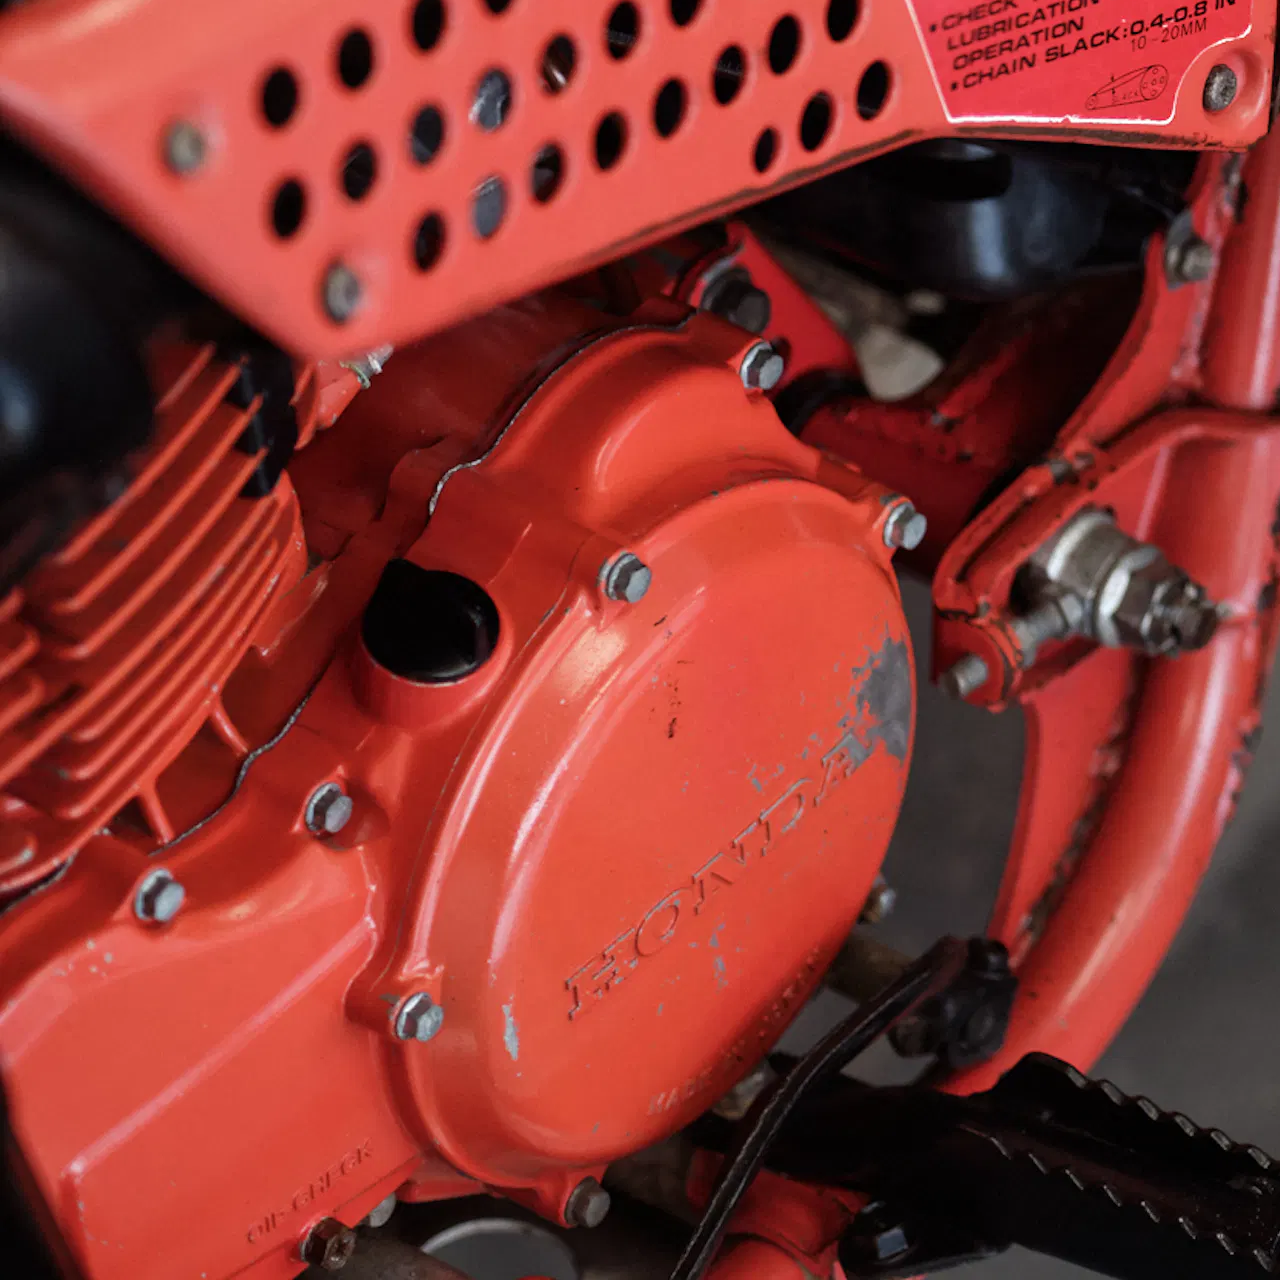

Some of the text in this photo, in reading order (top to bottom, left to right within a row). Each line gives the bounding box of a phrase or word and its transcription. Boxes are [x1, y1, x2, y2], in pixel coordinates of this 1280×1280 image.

[953, 16, 1084, 70] OPERATION
[962, 53, 1036, 89] CHAIN
[564, 731, 871, 1021] HONDA
